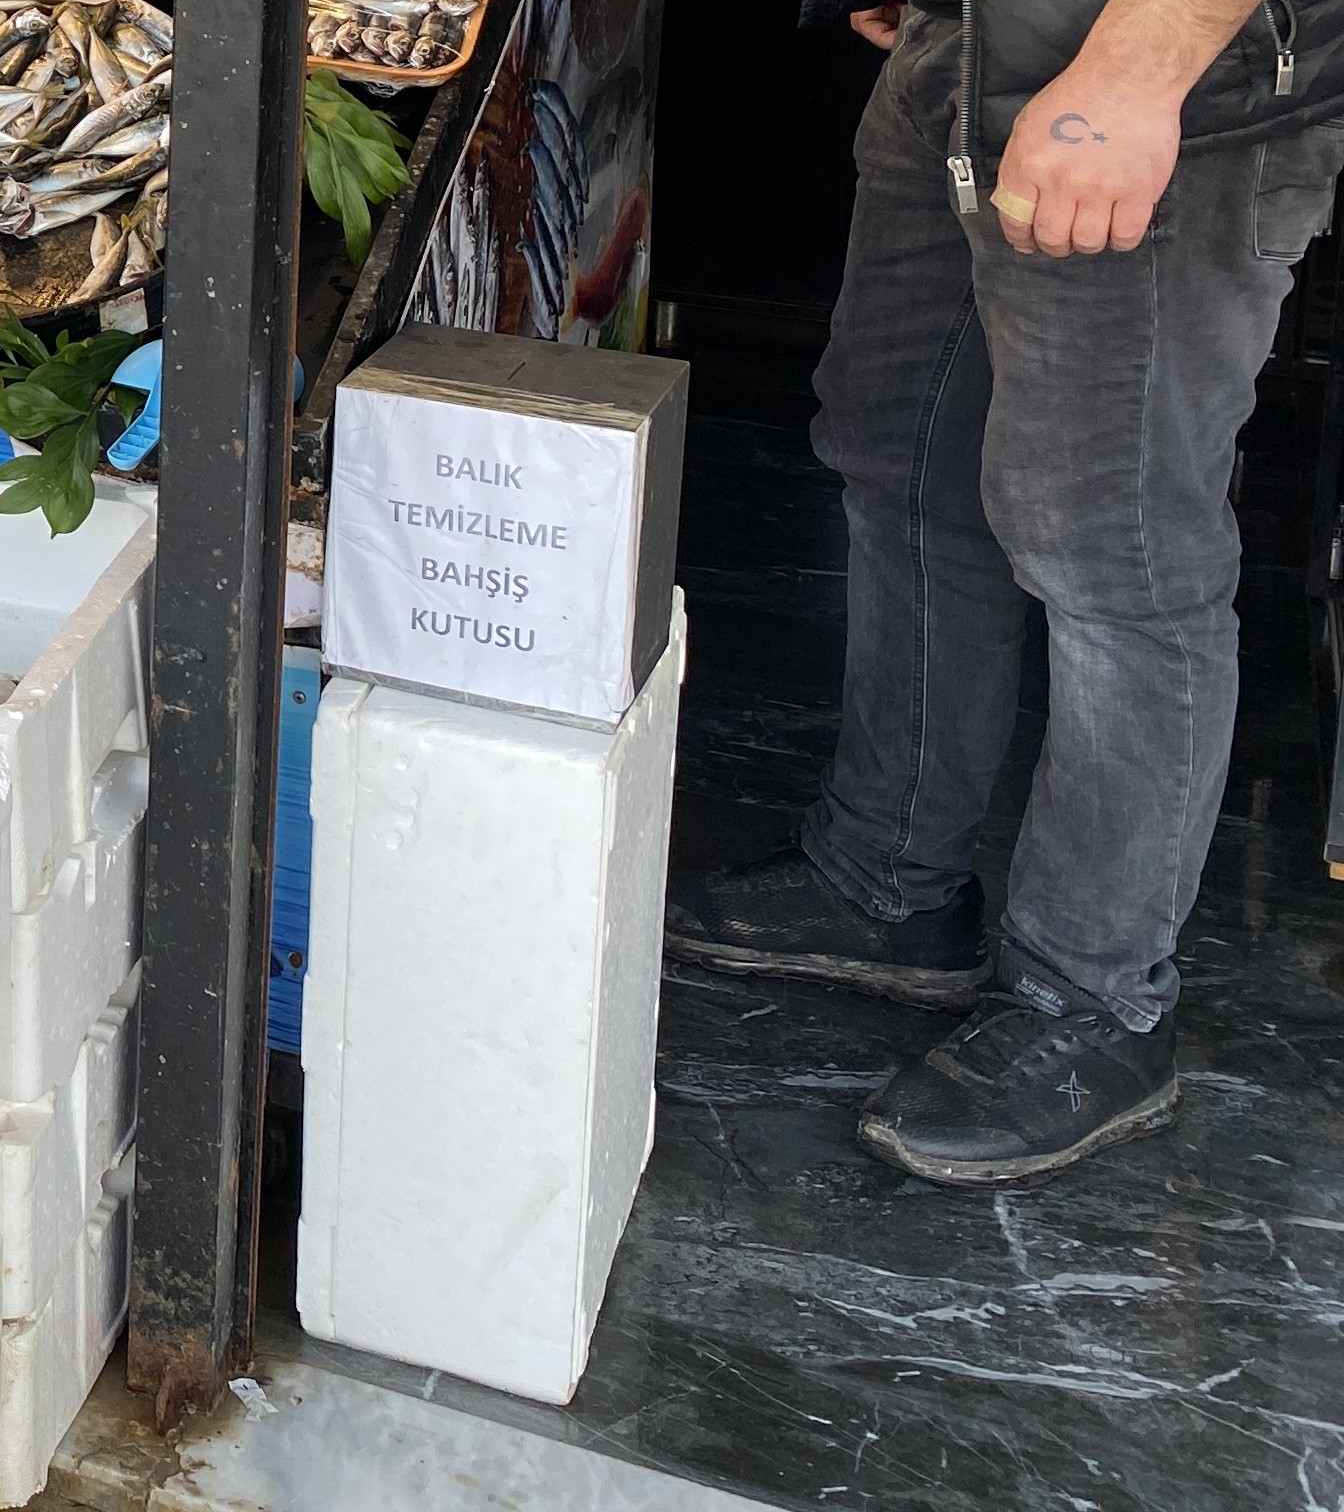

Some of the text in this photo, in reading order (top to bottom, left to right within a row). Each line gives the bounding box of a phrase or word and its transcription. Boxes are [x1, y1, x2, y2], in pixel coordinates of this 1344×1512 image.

[435, 453, 523, 490] BALIK
[387, 499, 568, 550] TEMİZLEME
[421, 556, 530, 604] BAHŞİŞ
[411, 607, 536, 653] KUTUSU
